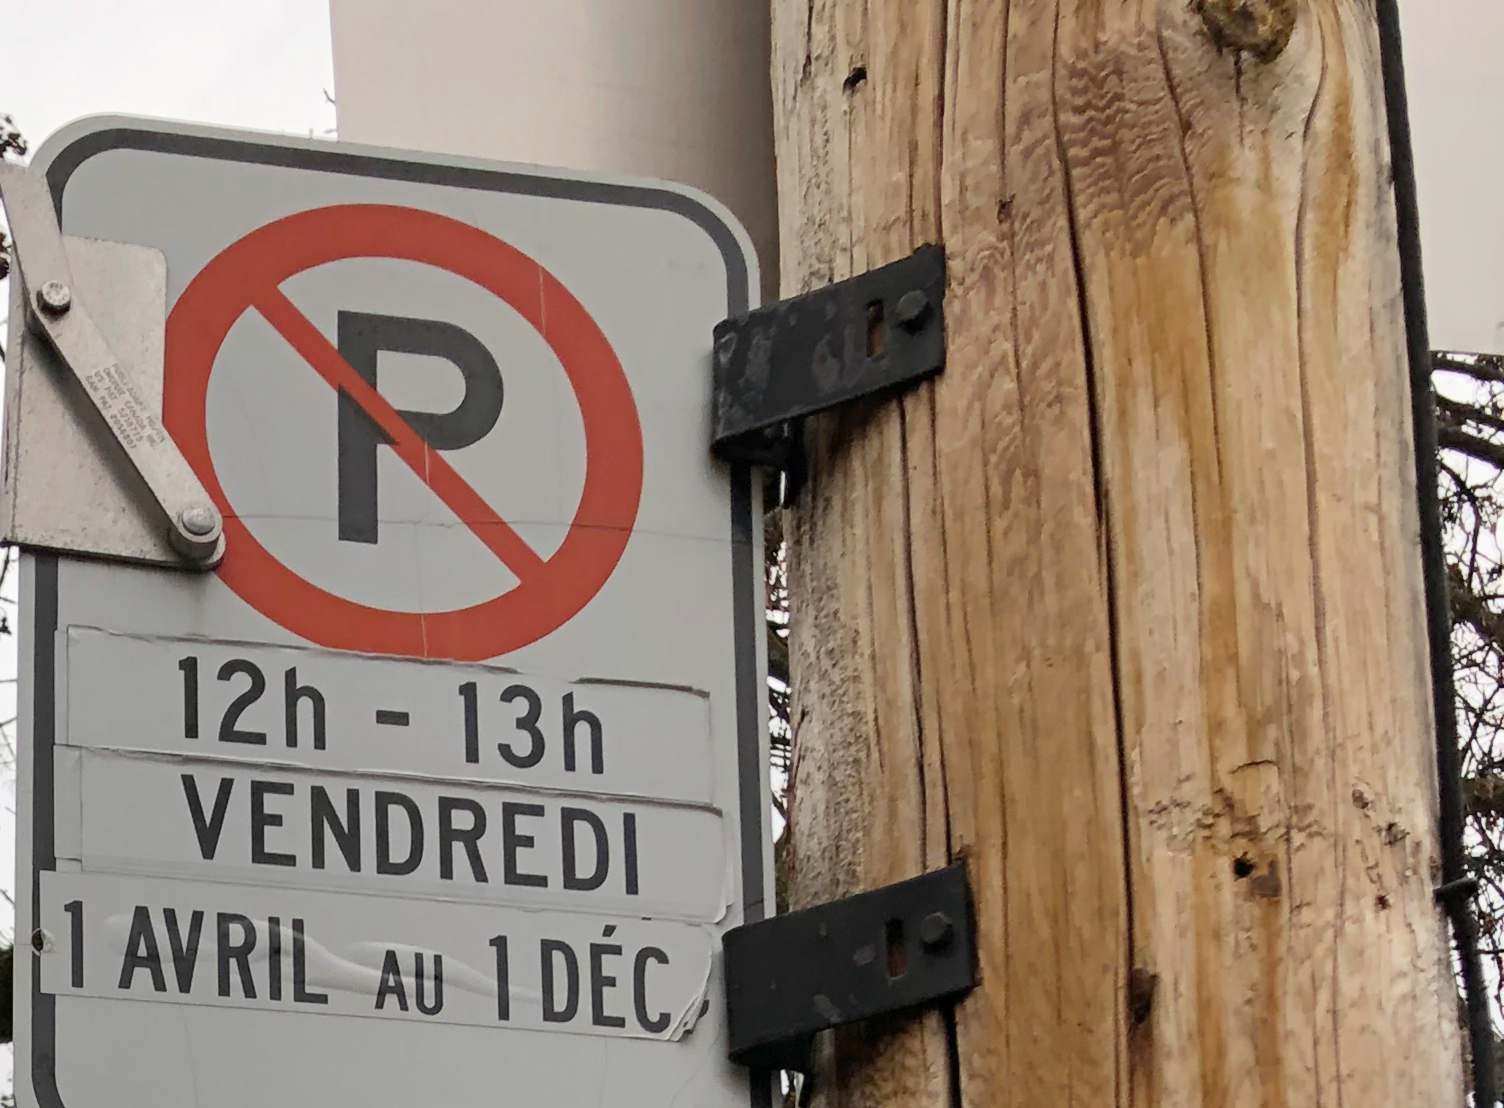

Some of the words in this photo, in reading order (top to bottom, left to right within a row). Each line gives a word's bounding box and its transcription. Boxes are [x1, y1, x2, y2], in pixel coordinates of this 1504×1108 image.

[338, 311, 503, 544] P
[179, 656, 326, 750] 12h
[376, 710, 409, 726] -
[459, 680, 604, 773] 13h
[181, 773, 640, 895] VENDREDI
[64, 900, 83, 988] 1
[118, 906, 328, 1004] AVRIL
[375, 950, 443, 1016] AU
[489, 935, 509, 1021] 1
[541, 923, 671, 1033] DÉC
